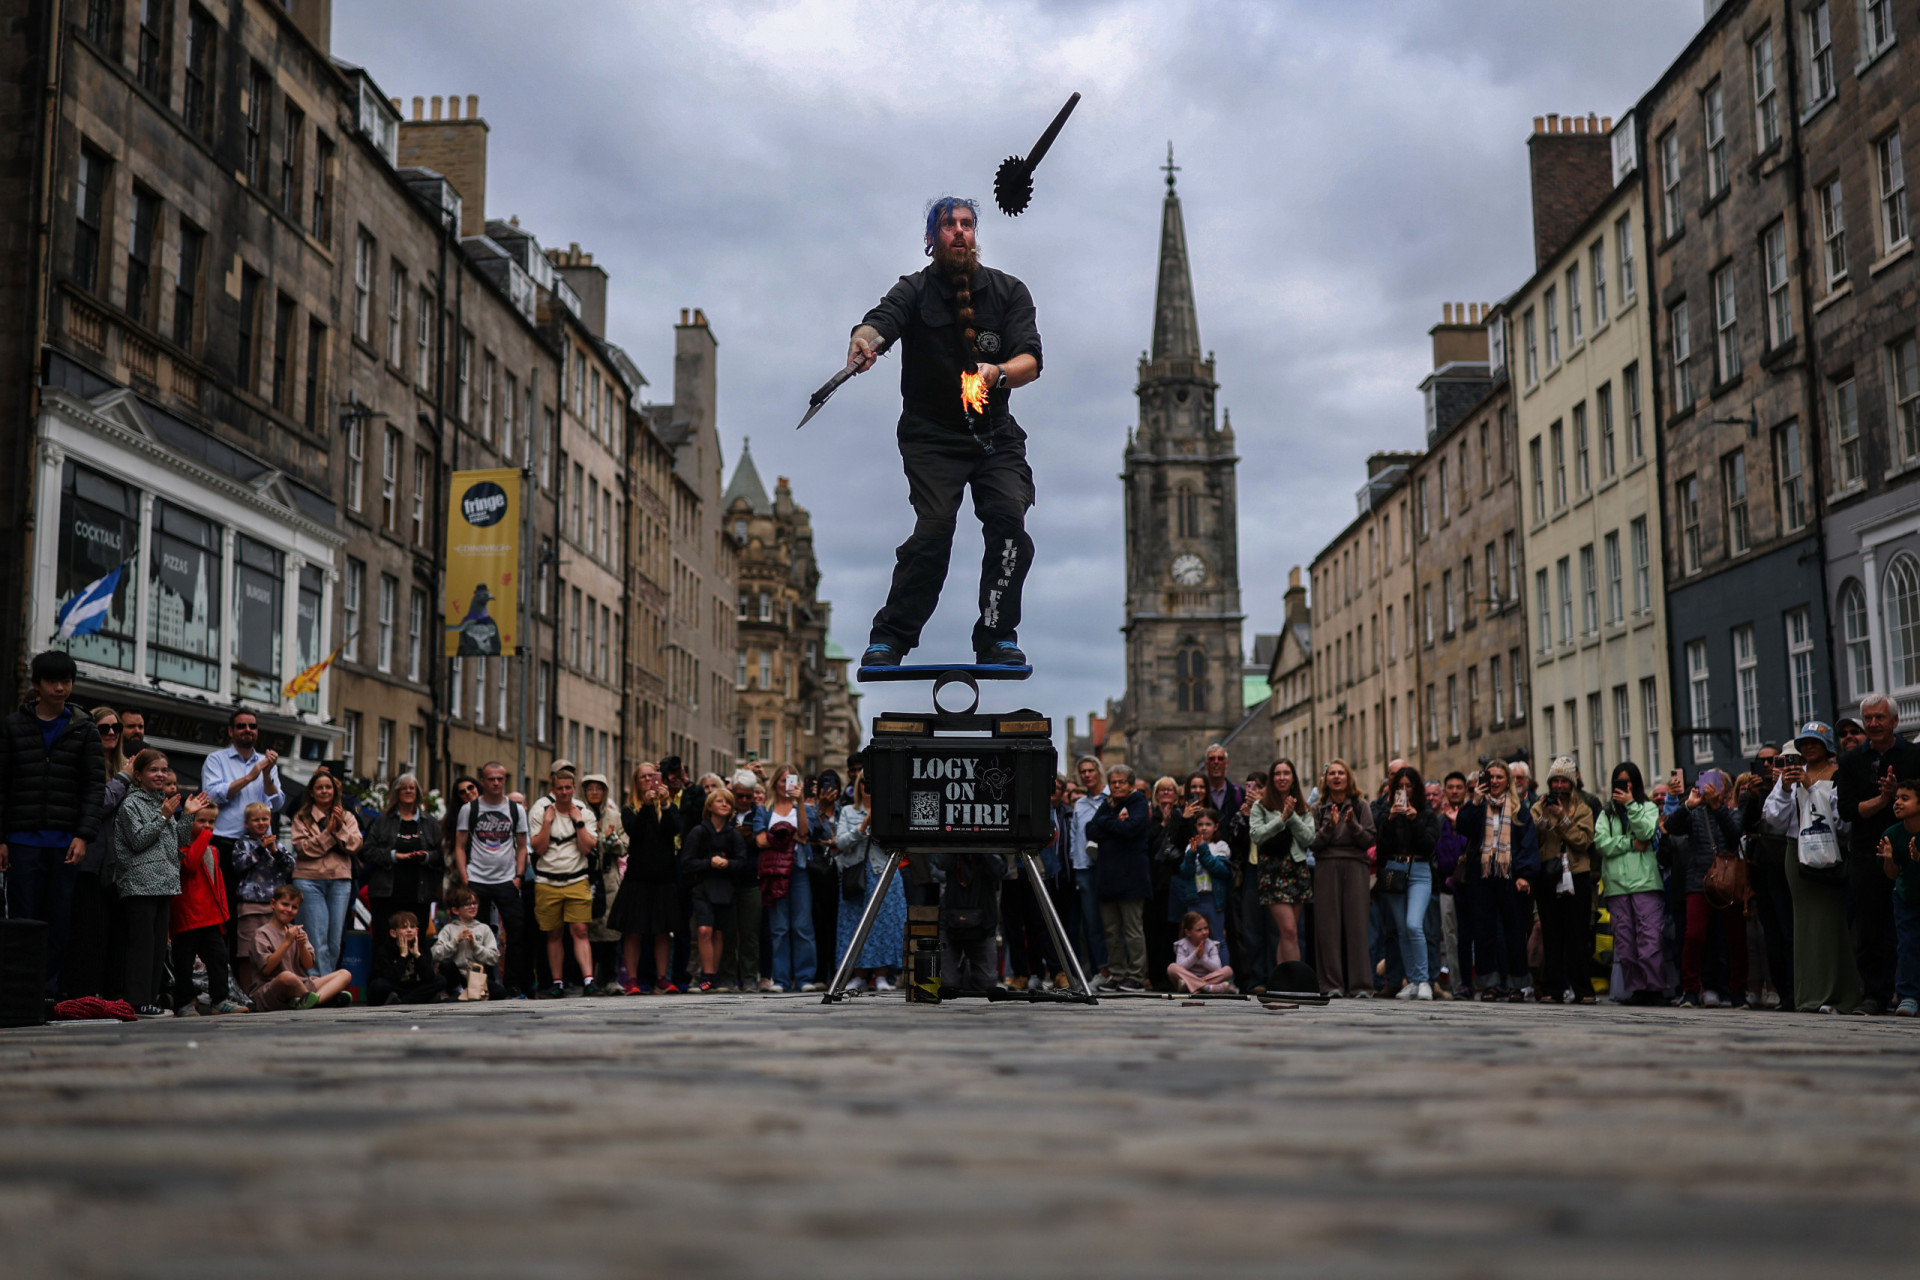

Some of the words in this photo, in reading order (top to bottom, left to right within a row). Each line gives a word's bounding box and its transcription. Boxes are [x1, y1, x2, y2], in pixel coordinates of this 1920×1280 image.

[464, 494, 505, 514] fringe
[74, 520, 121, 550] COCKTAILS
[163, 553, 189, 575] PIZZAS
[997, 578, 1009, 587] ON
[912, 758, 979, 779] LOGY
[945, 782, 975, 801] ON
[945, 803, 1010, 825] FIRE
[475, 820, 512, 833] SUPER
